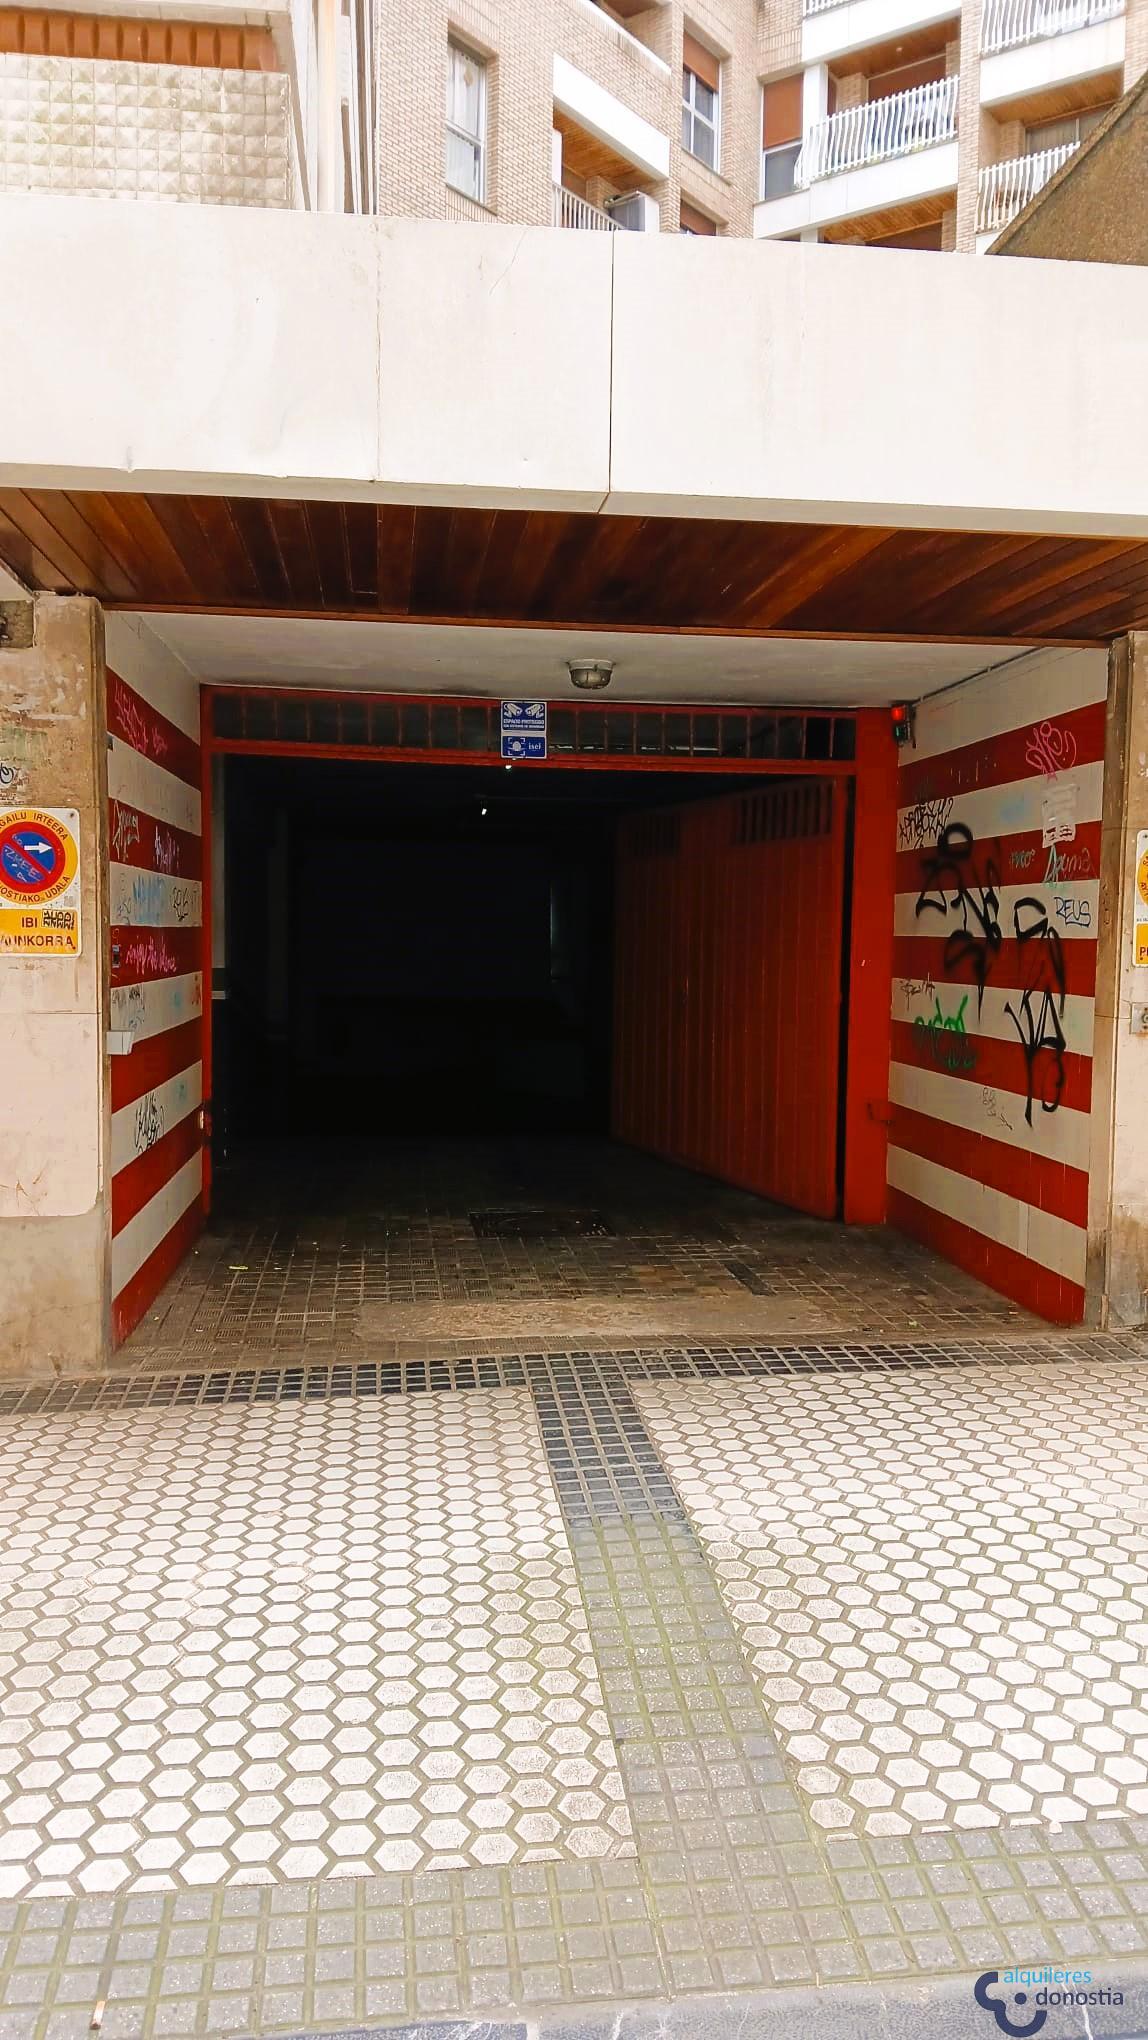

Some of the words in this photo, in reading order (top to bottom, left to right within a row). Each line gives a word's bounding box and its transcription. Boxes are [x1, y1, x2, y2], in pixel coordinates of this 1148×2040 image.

[0, 812, 27, 829] GAILU
[33, 813, 68, 840] IRTEERA
[0, 886, 41, 903] OSTIAKO
[44, 876, 71, 899] UDALA
[21, 917, 38, 928] IBI
